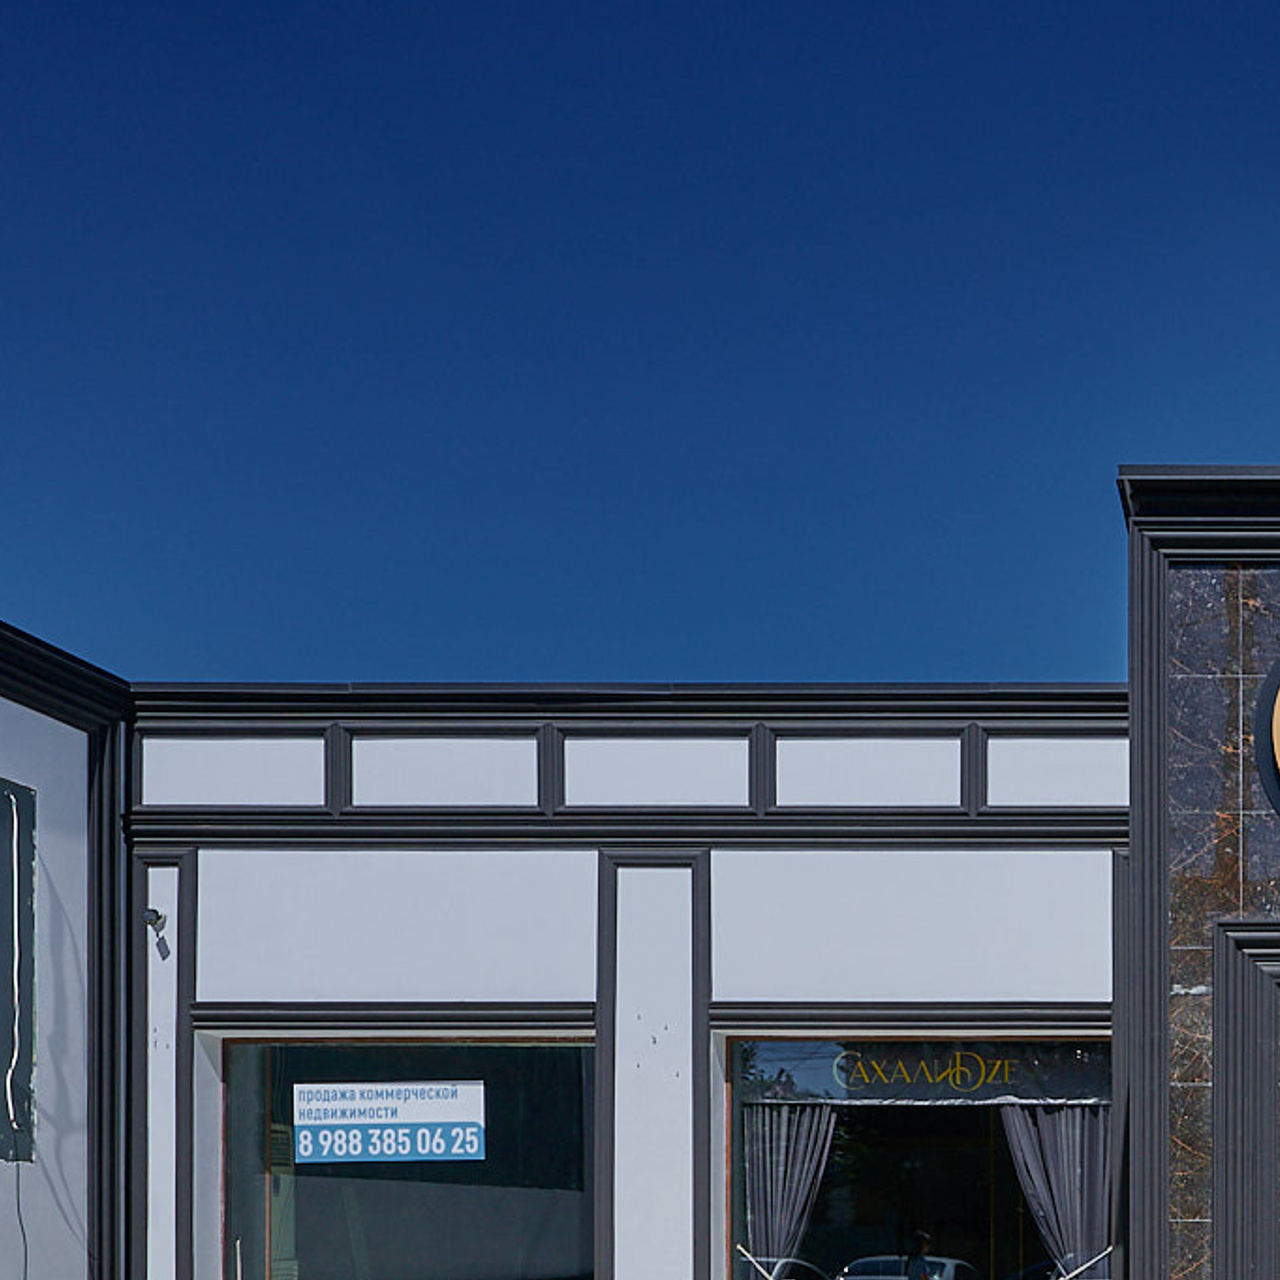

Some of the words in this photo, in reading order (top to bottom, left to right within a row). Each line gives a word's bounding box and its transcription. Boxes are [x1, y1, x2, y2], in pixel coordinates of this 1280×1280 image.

[299, 1088, 356, 1104] продажа
[359, 1085, 458, 1104] коммерческой
[299, 1106, 398, 1121] недвижимости
[299, 1131, 313, 1156] 8
[318, 1130, 362, 1156] 988
[368, 1129, 411, 1155] 385
[416, 1128, 446, 1154] 06
[450, 1127, 479, 1154] 25
